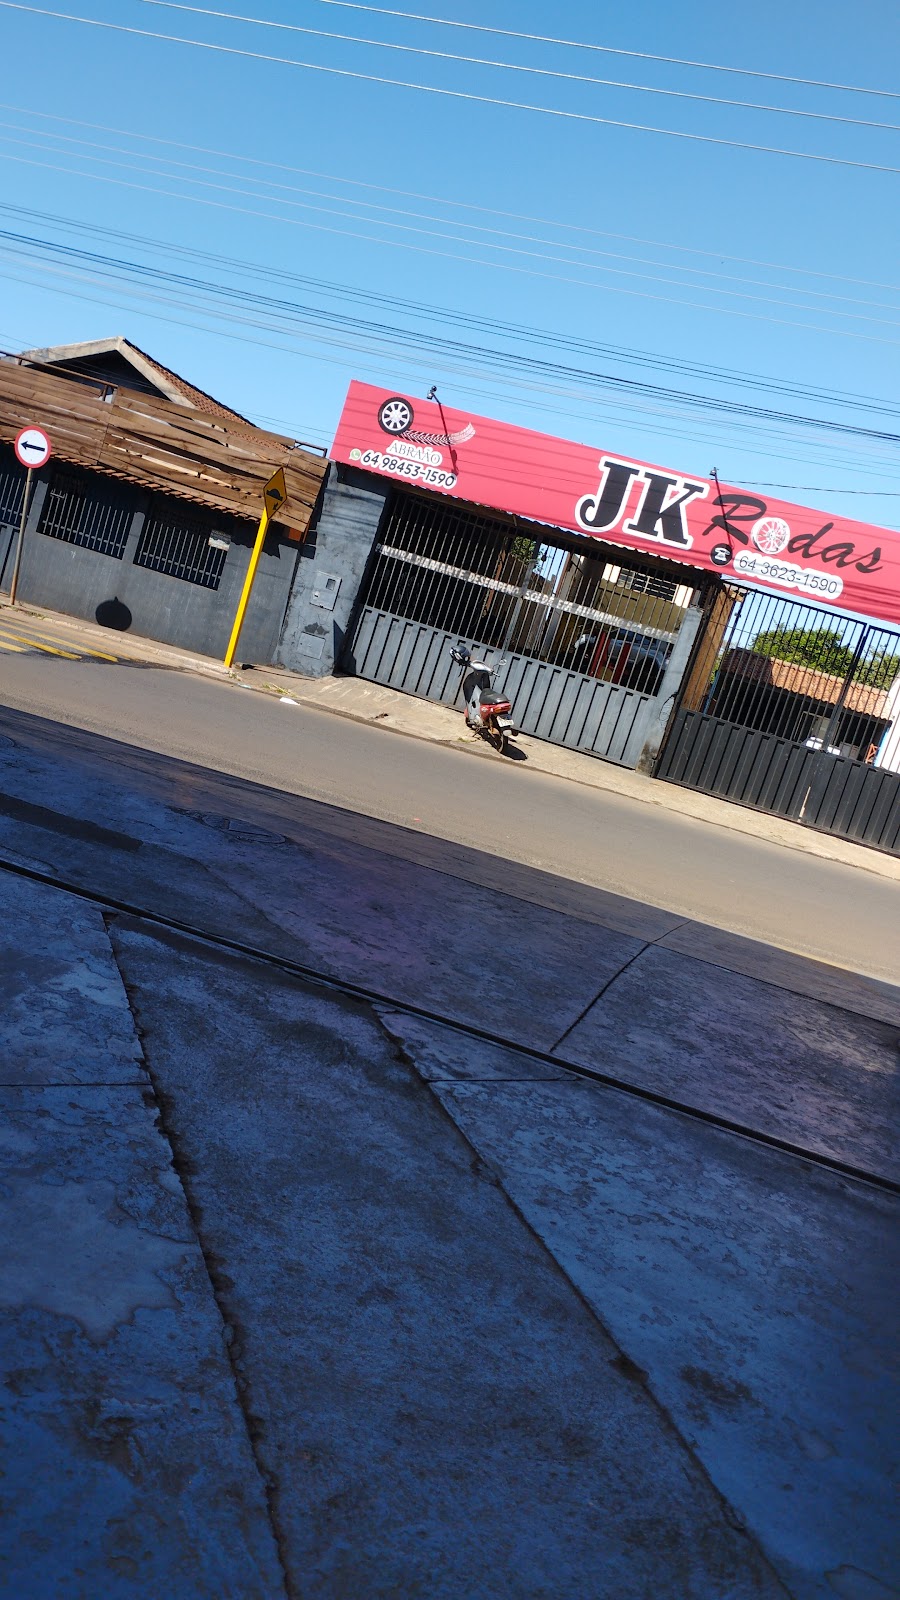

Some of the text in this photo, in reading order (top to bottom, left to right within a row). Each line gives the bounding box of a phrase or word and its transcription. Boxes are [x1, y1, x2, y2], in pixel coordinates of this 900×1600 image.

[363, 451, 456, 487] 64 98453-1590
[389, 442, 441, 464] ABRAÃO
[578, 458, 706, 547] JK
[738, 555, 838, 594] 64 3623-1590
